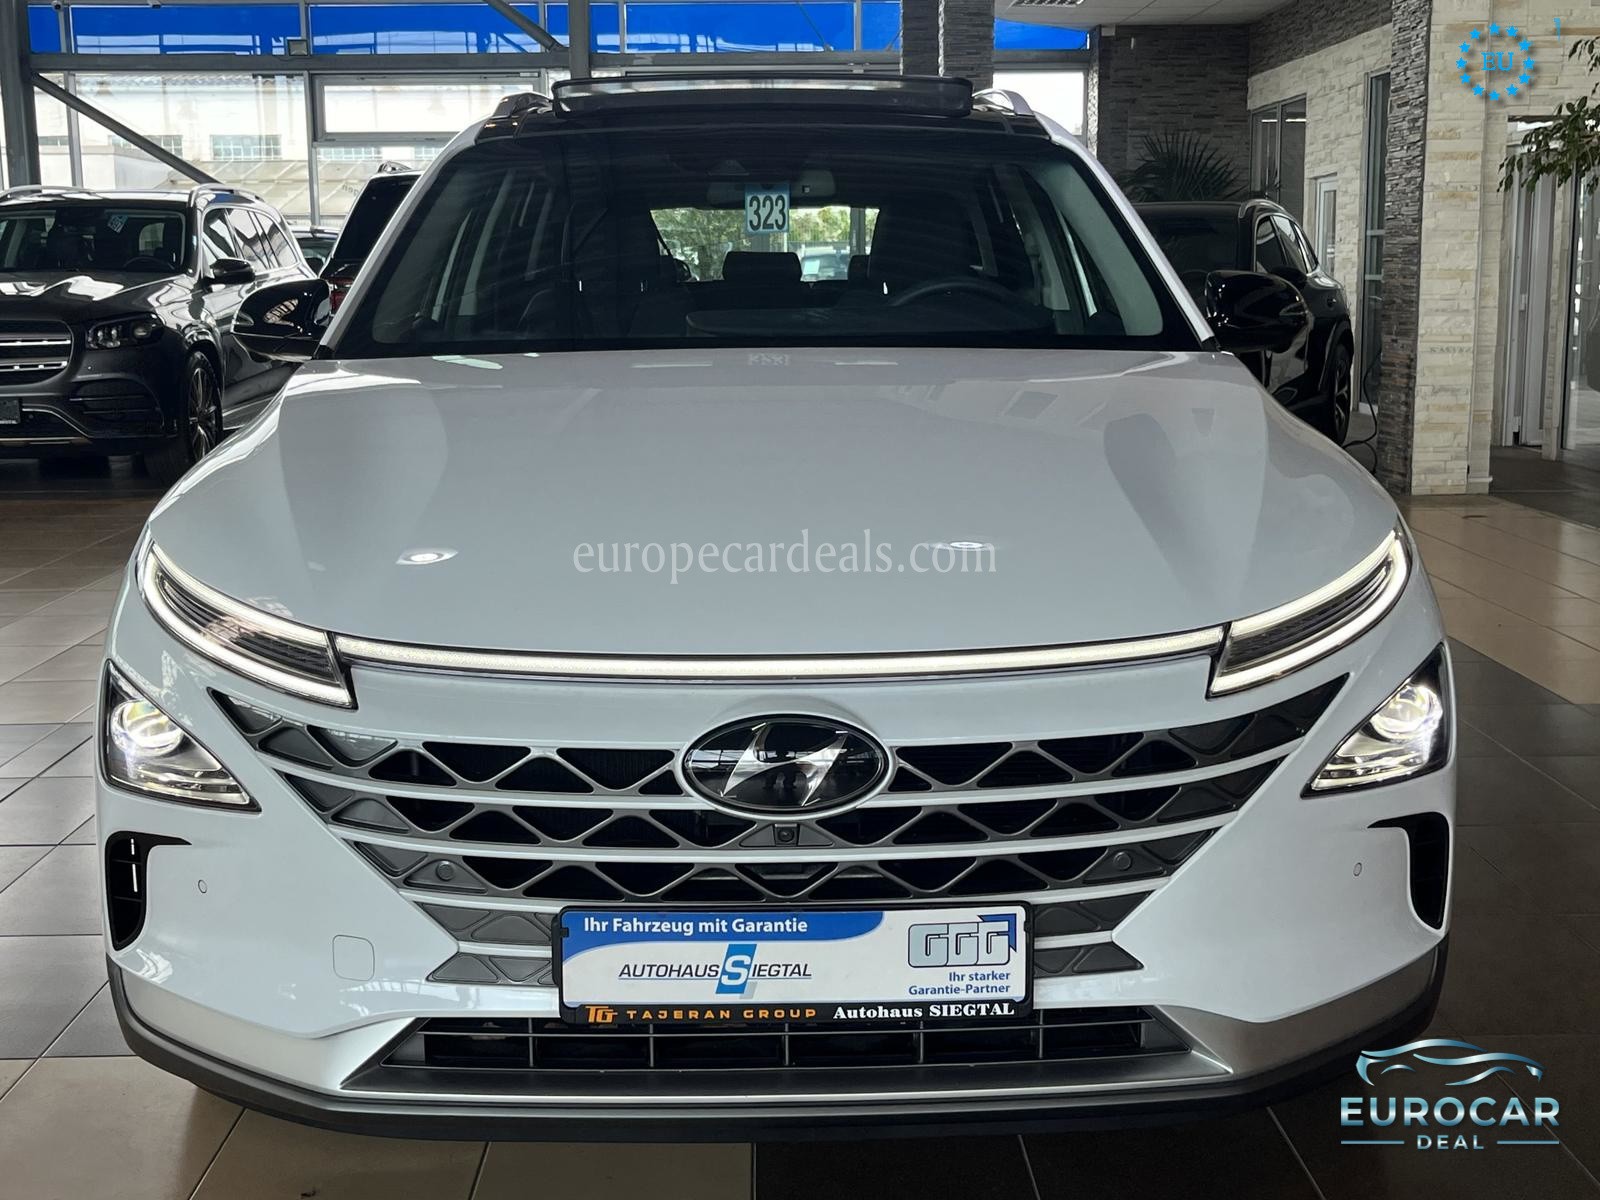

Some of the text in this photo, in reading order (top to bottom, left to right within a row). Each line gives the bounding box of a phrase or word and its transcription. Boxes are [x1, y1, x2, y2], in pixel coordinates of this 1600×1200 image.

[749, 195, 786, 231] 323
[584, 917, 808, 936] Ihr Fahrzeug mit Garantie
[949, 971, 1011, 981] Ihr starker
[908, 983, 1010, 996] Garantie-Partner
[627, 1009, 730, 1020] TAJERAN
[743, 1009, 816, 1019] GROUP
[833, 1002, 1015, 1020] Autohaus SIEGTAL
